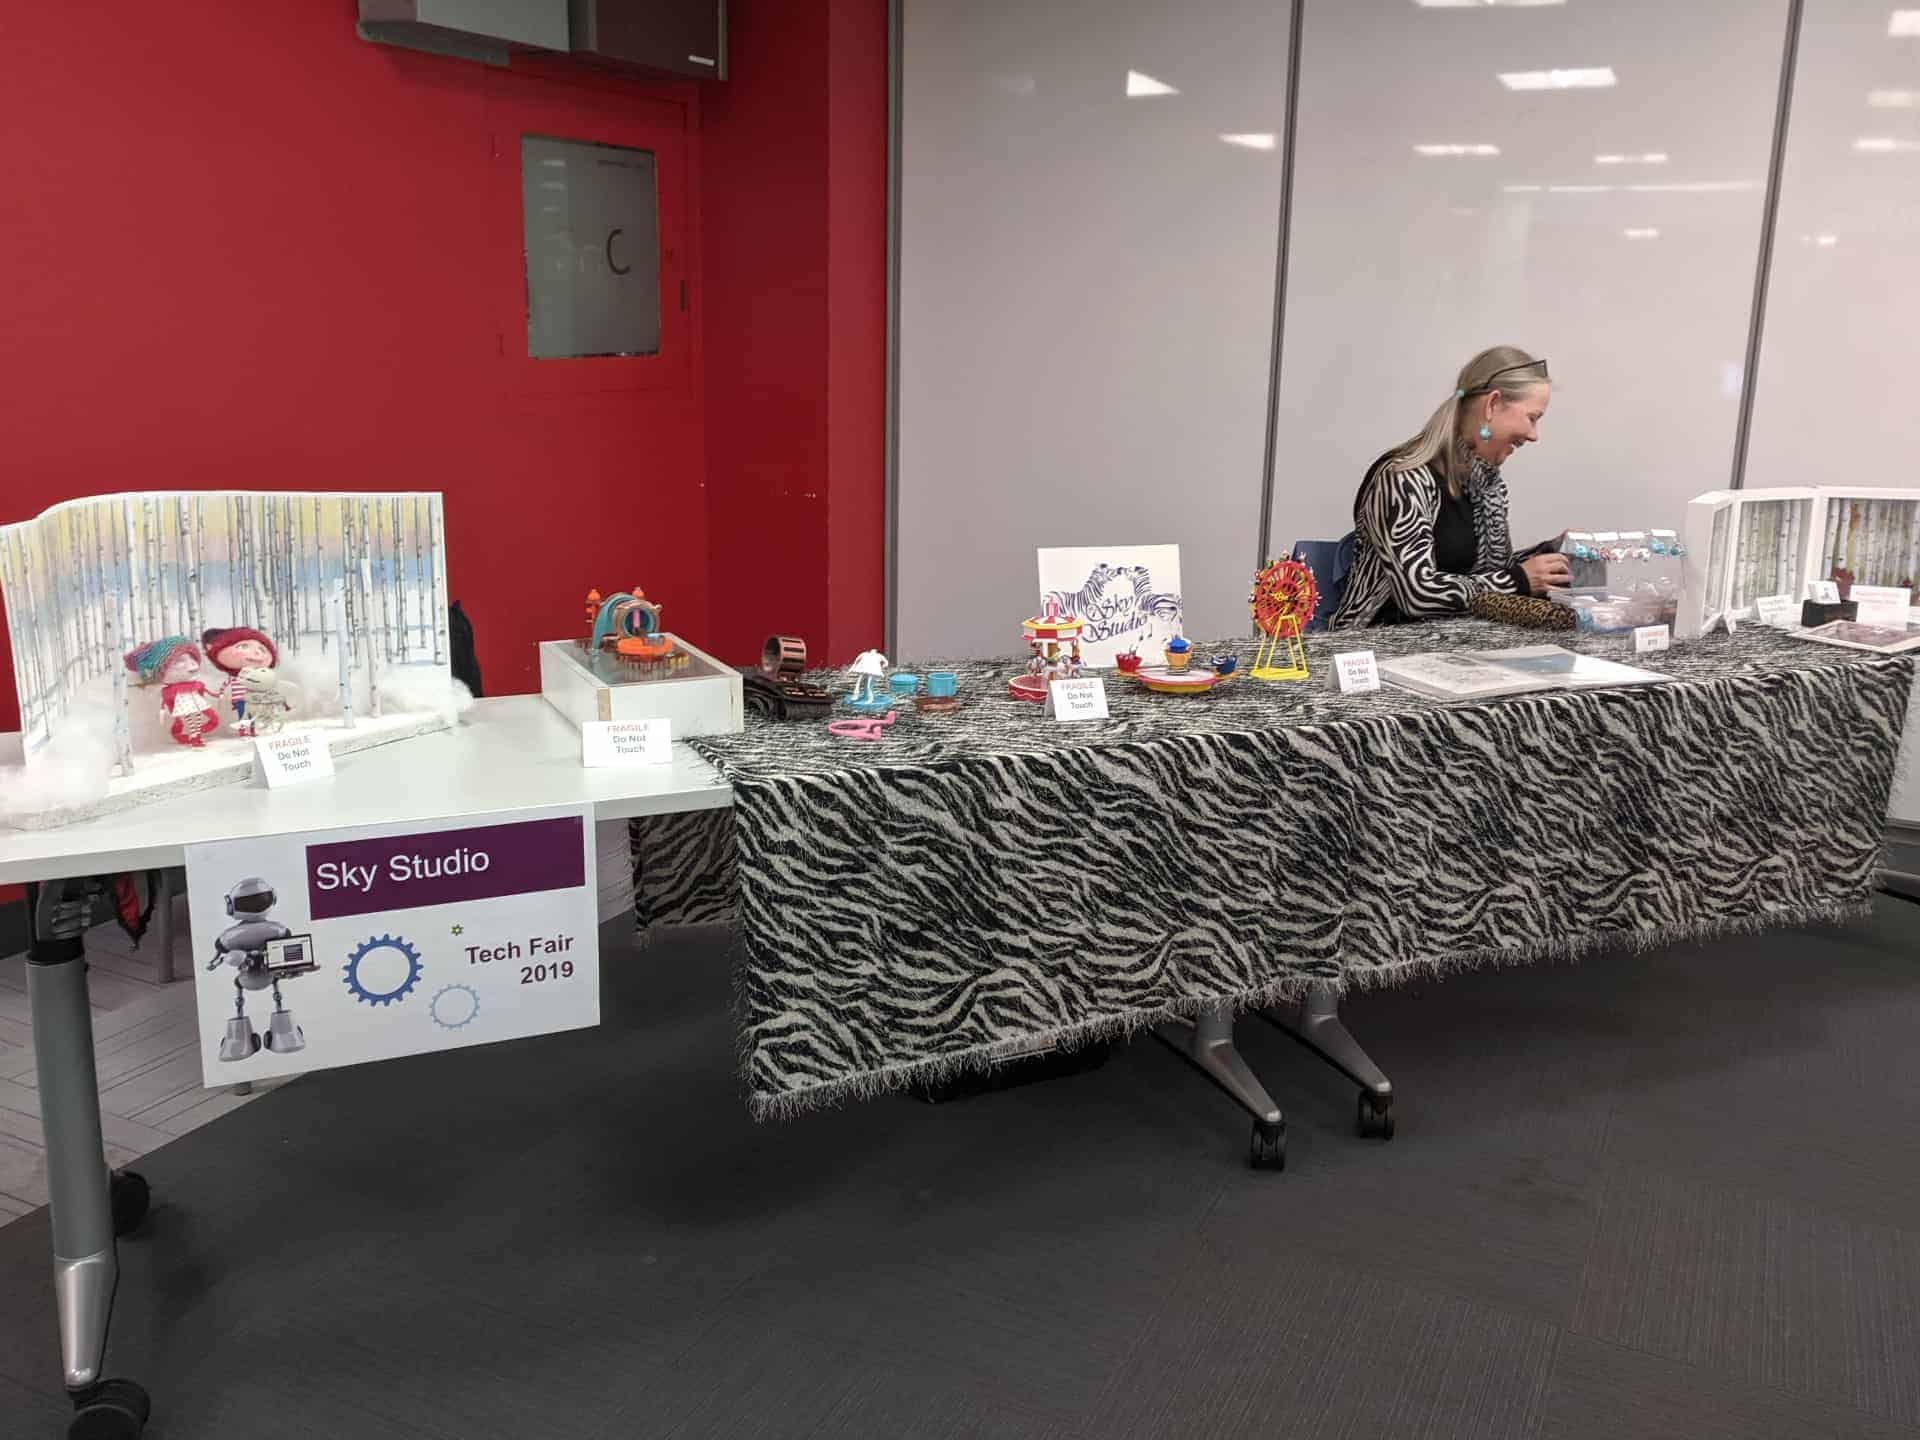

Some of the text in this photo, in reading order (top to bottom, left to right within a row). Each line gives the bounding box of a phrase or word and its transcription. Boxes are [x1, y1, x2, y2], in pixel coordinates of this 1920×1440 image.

[1086, 594, 1134, 621] Sky
[1082, 611, 1148, 643] Studio
[1061, 681, 1097, 690] FRAGILE
[1067, 691, 1094, 700] Do Not
[1070, 701, 1094, 710] Touch
[268, 735, 312, 750] FRAGILE
[612, 734, 646, 743] Do Not
[278, 747, 310, 761] Do Not
[615, 744, 646, 754] Touch
[281, 760, 311, 772] Touch
[316, 848, 490, 892] Sky Studio
[465, 934, 574, 965] Tech Fair
[520, 960, 574, 985] 2019
